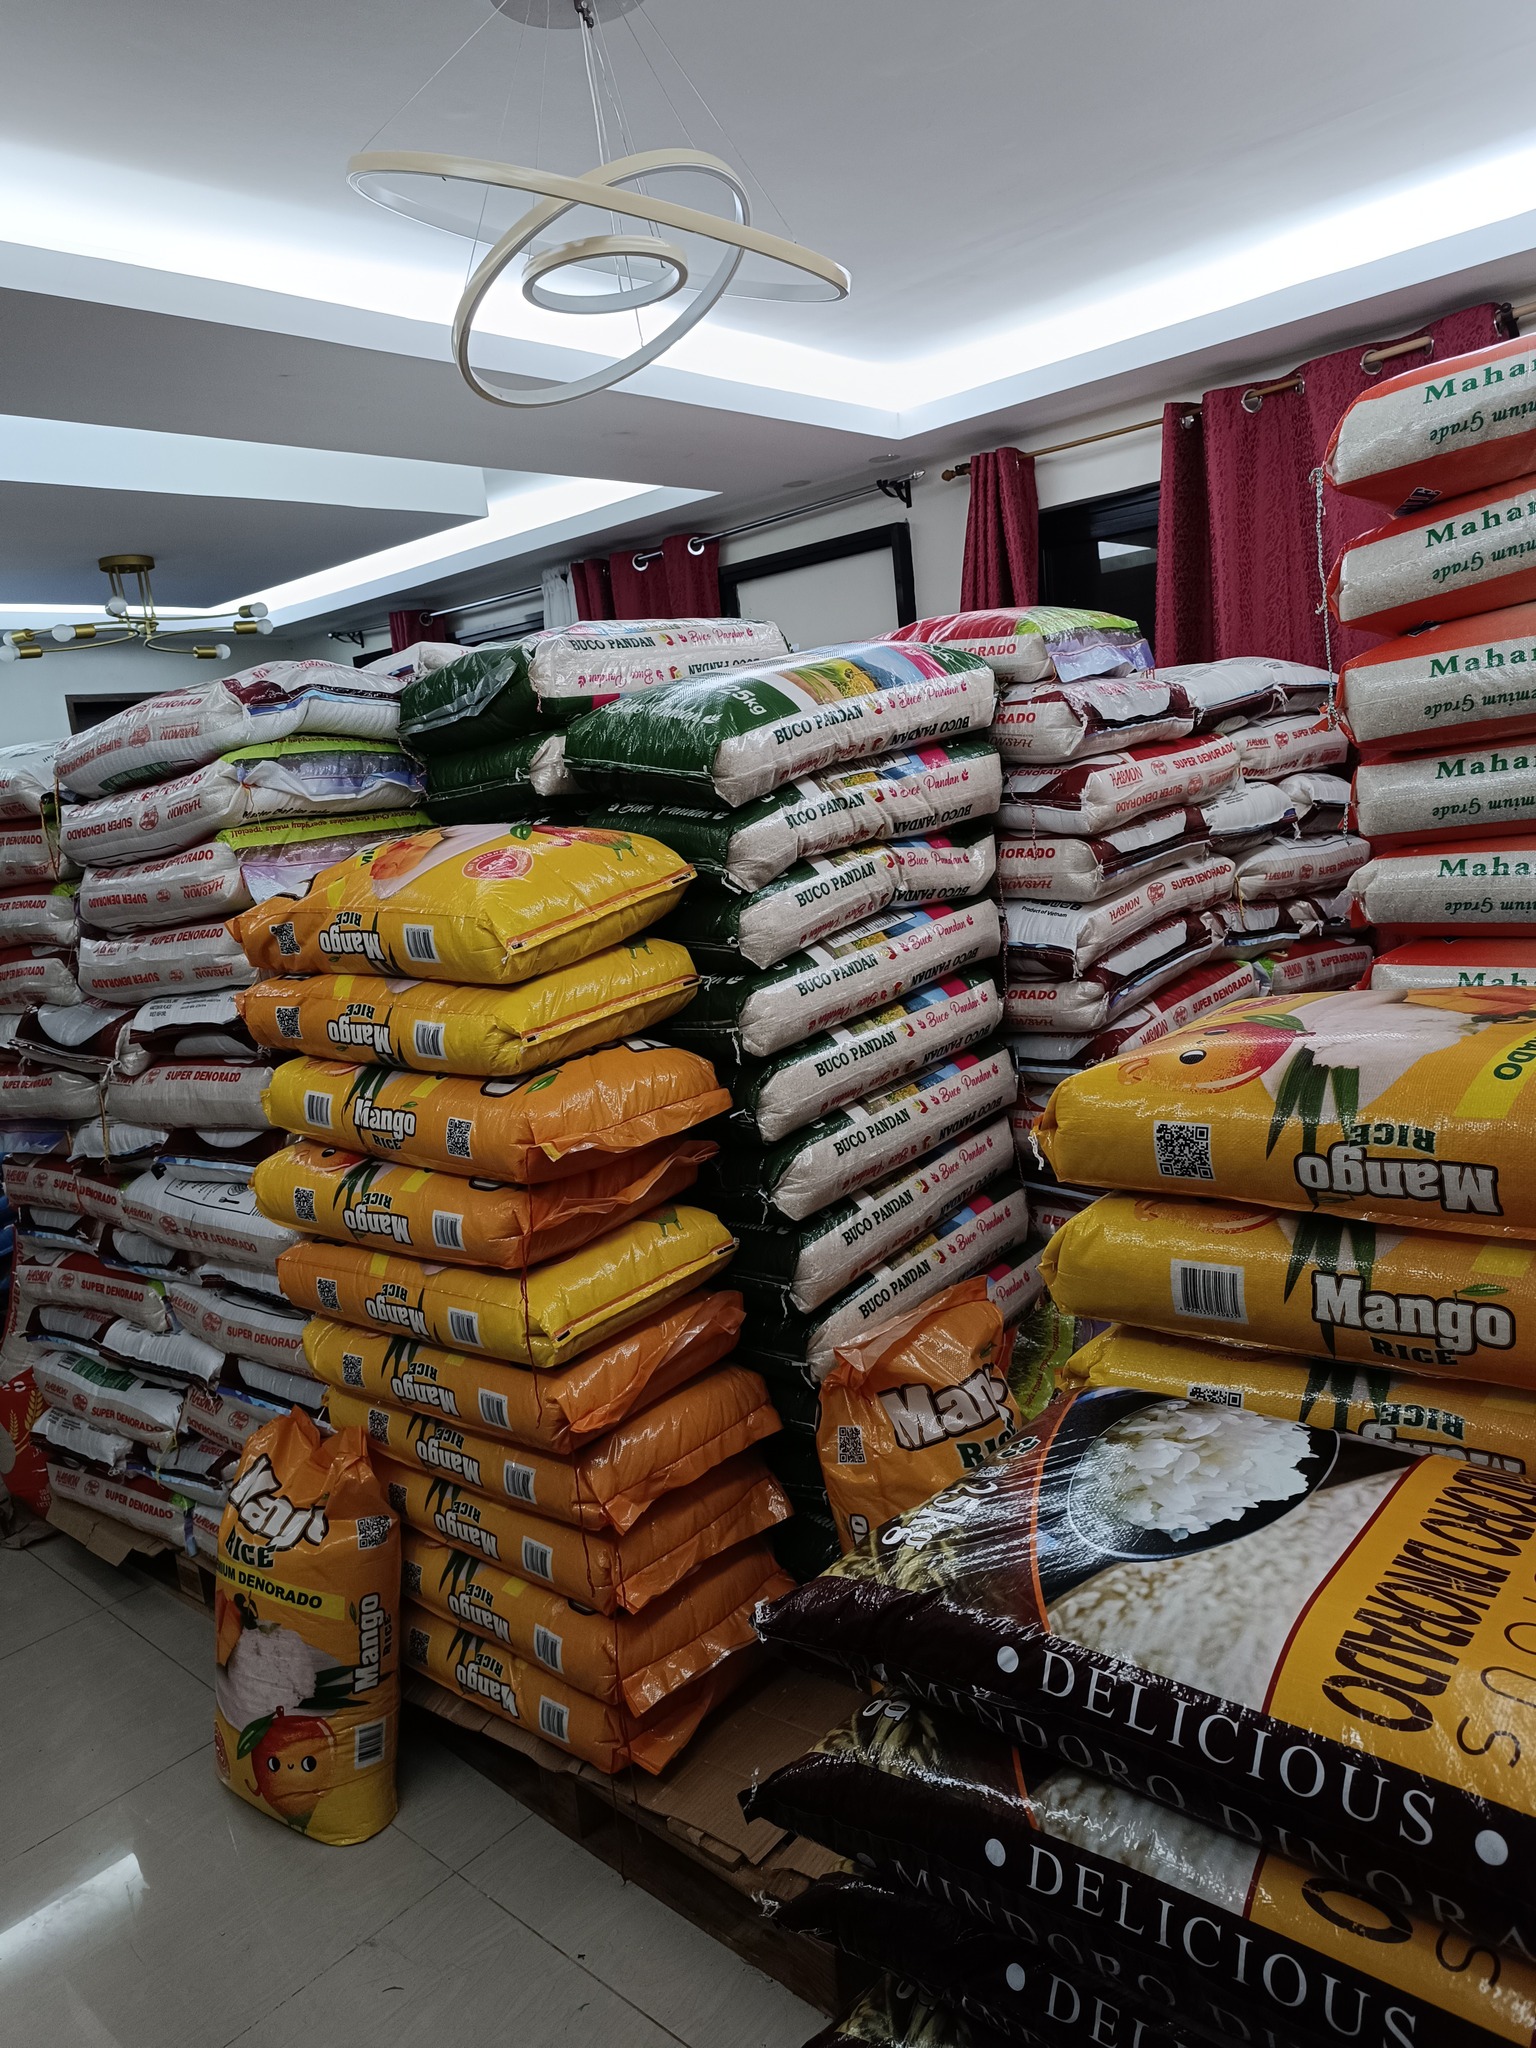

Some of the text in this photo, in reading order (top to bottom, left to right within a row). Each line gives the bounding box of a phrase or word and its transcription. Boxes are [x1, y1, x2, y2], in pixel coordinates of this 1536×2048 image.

[1429, 410, 1484, 445] Grade
[1432, 551, 1483, 583] Grade
[569, 635, 656, 651] BUCO PANDAN
[717, 685, 768, 716] 25kg
[1424, 694, 1475, 719] Grade
[772, 705, 864, 745] BUCO PANDAN
[889, 716, 969, 746] BUCO PANDAN
[1172, 757, 1198, 770] SUPER
[923, 776, 960, 793] Pandan
[820, 792, 866, 817] PANDAN
[940, 803, 972, 822] BUCO
[1116, 787, 1158, 813] DENORADO
[1432, 798, 1482, 820] Grade
[66, 822, 107, 841] DENORADO
[108, 817, 133, 832] SUPER
[5, 834, 43, 846] DENORADO
[907, 851, 929, 867] Buco
[1318, 864, 1337, 876] SUPER
[121, 893, 148, 904] SUPER
[795, 861, 876, 908] BUCO PANDAN
[937, 886, 970, 898] BUCO
[1109, 864, 1232, 922] HASMON SUPER DENORADO
[11, 900, 47, 910] DENORADO
[336, 911, 362, 927] RICE
[1021, 905, 1041, 914] Product
[1444, 897, 1494, 915] Grade
[150, 928, 224, 946] SUPER DENORADO
[319, 923, 386, 961] Mango
[908, 919, 966, 950] Buco Pandan
[15, 966, 45, 978] DENORADO
[795, 954, 879, 997] BUCO PANDAN
[912, 946, 979, 988] BUCO PANDAN
[1320, 957, 1340, 968] SUPER
[92, 974, 134, 989] DENORADO
[136, 972, 160, 983] SUPER
[1192, 996, 1213, 1014] SUPER
[1214, 973, 1253, 1002] DENORADO
[346, 1003, 376, 1020] RICE
[926, 1011, 949, 1028] Buco
[327, 1015, 393, 1056] Mango
[815, 1031, 897, 1078] BUCO PANDAN
[922, 1036, 962, 1065] PANDAN
[165, 1071, 242, 1083] SUPER DENORADO
[940, 1069, 993, 1103] Buco Pandan
[353, 1097, 416, 1143] Mango
[833, 1108, 911, 1157] BUCO PANDAN
[372, 1133, 402, 1150] RICE
[1348, 1122, 1437, 1155] RICE
[939, 1143, 988, 1180] Buco Pandan
[53, 1178, 77, 1192] SUPER
[77, 1185, 118, 1206] DENORADO
[1294, 1142, 1503, 1215] Mango
[362, 1192, 393, 1209] RICE
[343, 1203, 413, 1245] Mango
[842, 1189, 914, 1246] BUCO PANDAN
[956, 1214, 1006, 1249] Buco Pandan
[80, 1279, 105, 1294] SUPER
[106, 1284, 144, 1302] DENORADO
[381, 1283, 408, 1301] RICE
[859, 1259, 932, 1319] BUCO PANDAN
[365, 1292, 430, 1337] Mango
[1311, 1270, 1517, 1355] Mango
[226, 1326, 252, 1340] SUPER
[1370, 1337, 1460, 1366] RICE
[408, 1362, 438, 1382] RICE
[391, 1372, 462, 1418] Mango
[91, 1406, 115, 1420] SUPER
[116, 1410, 164, 1432] DENORADO
[1378, 1403, 1466, 1440] RICE
[435, 1427, 465, 1449] RICE
[416, 1437, 485, 1488] Mango
[105, 1488, 174, 1519] SUPER DENORADO
[451, 1500, 482, 1523] RICE
[224, 1523, 277, 1568] RICE
[434, 1510, 500, 1561] Mango
[238, 1570, 323, 1610] DENORADO
[465, 1583, 494, 1607] RICE
[448, 1591, 512, 1645] Mango
[354, 1593, 381, 1693] Mango
[382, 1612, 393, 1659] RICE
[475, 1653, 504, 1678] RICE
[456, 1660, 520, 1720] Mango
[901, 1670, 1187, 1808] MINDORO
[1037, 1649, 1436, 1846] DELICIOUS
[1026, 1843, 1416, 2048] DELICIOUS
